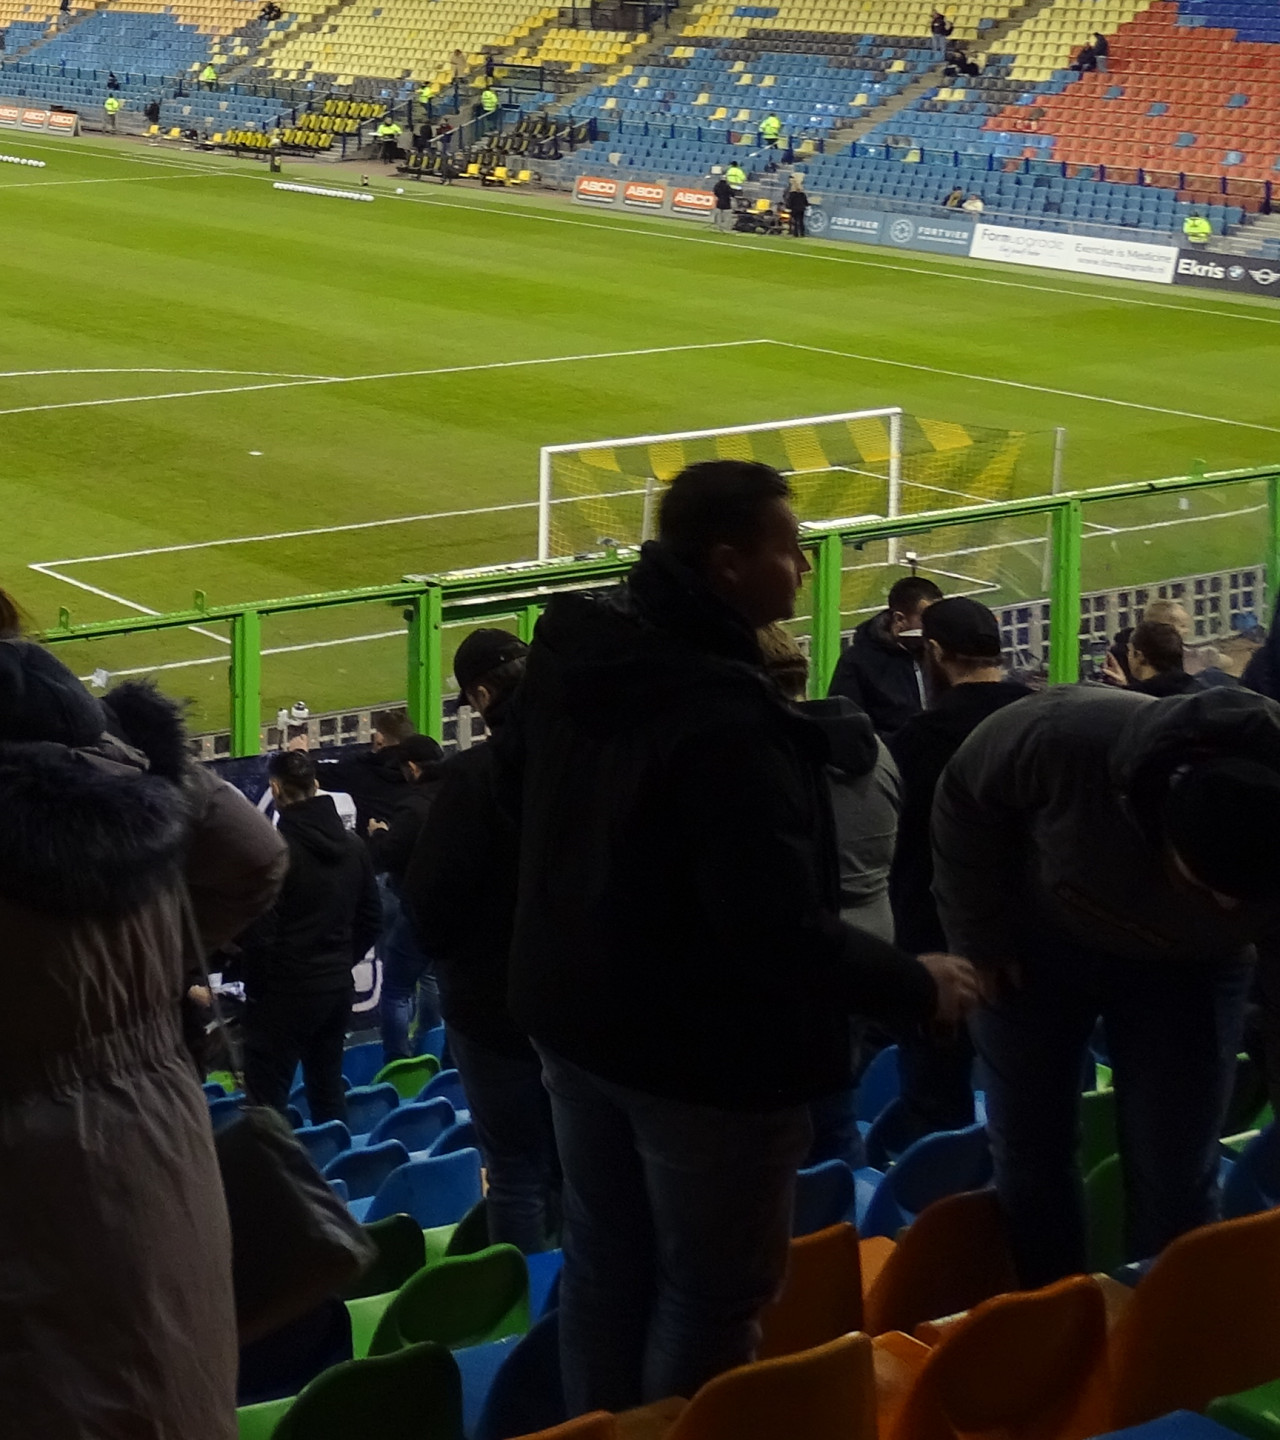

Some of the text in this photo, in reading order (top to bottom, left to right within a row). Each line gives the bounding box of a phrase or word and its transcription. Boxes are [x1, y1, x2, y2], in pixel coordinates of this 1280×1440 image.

[578, 179, 616, 196] ABCO
[625, 185, 664, 202] ABCO
[673, 191, 714, 209] ABCO
[1074, 242, 1114, 257] Exercise
[1177, 257, 1226, 281] Ekris
